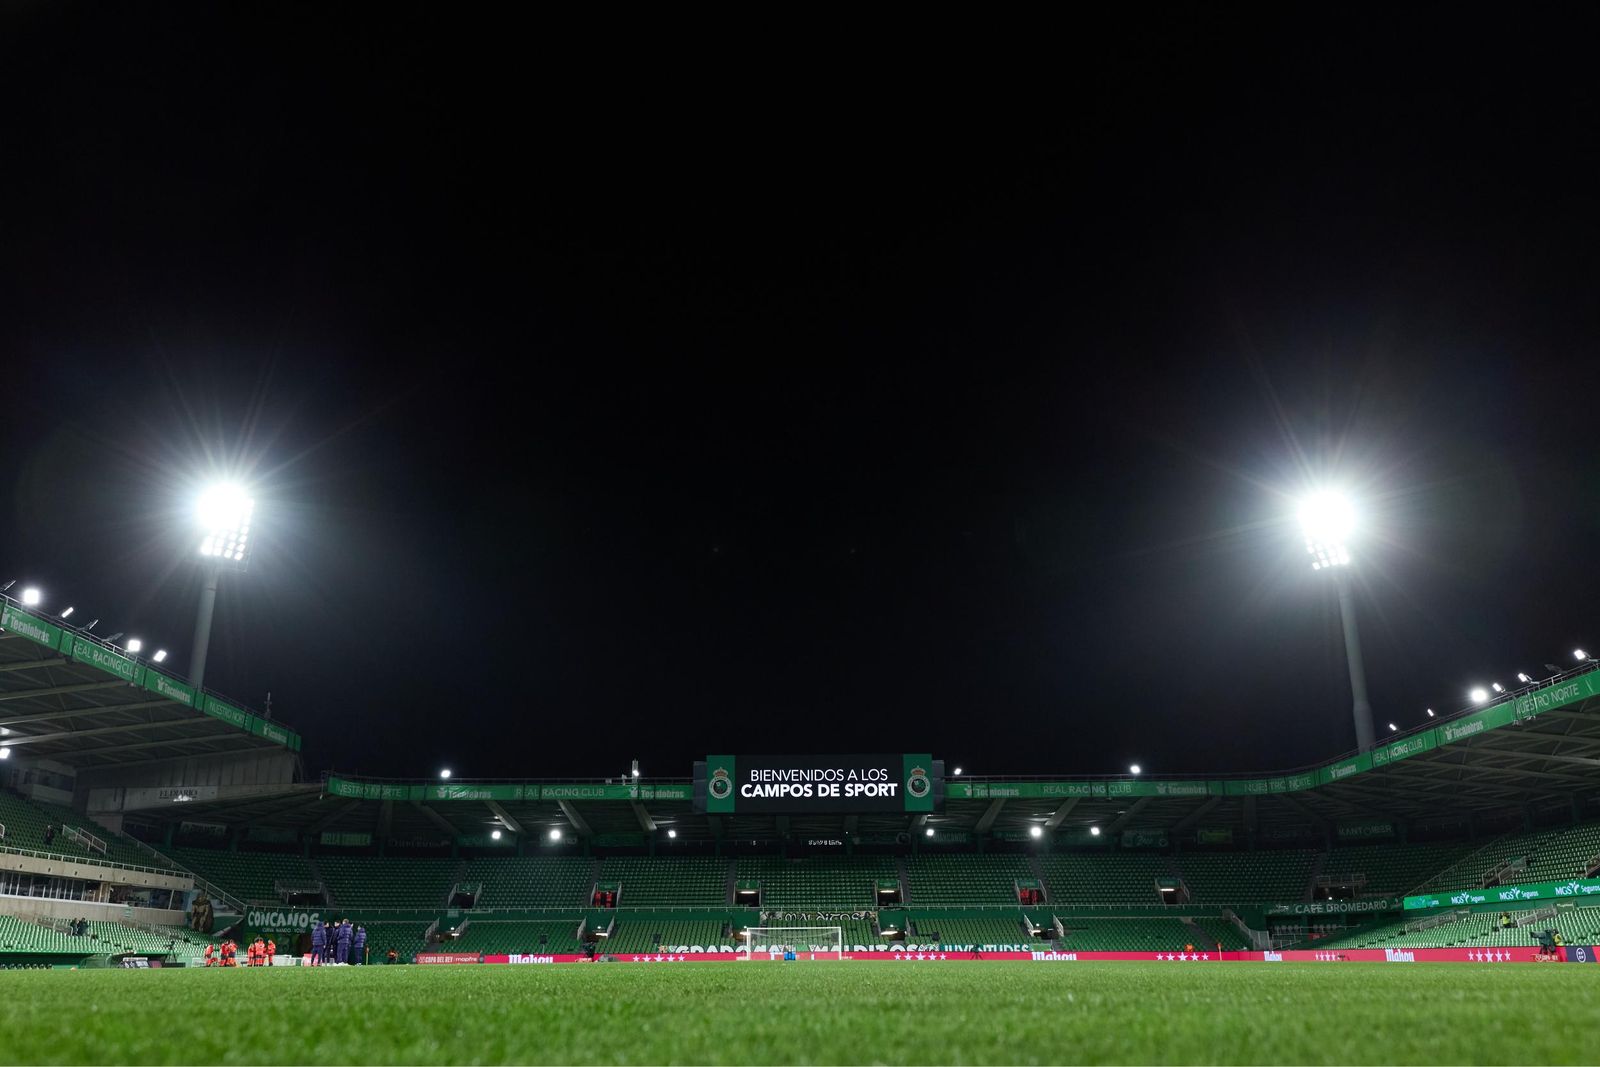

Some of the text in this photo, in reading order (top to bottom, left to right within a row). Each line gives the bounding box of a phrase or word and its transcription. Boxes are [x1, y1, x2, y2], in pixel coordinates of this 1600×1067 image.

[10, 615, 50, 643] Tecniobras
[73, 641, 139, 678] REAL RACING CLUB
[1551, 683, 1580, 702] NORTE
[751, 768, 888, 782] BIENVENIDOS A LOS
[516, 788, 605, 797] REAL RACING CLUB
[741, 784, 813, 798] CAMPOS
[818, 784, 841, 797] DE
[844, 783, 898, 797] SPORT
[1043, 784, 1132, 794] REAL RACING CLUB
[1499, 890, 1539, 900] MGS Seguros
[1555, 884, 1573, 895] MGS
[1326, 900, 1387, 912] DROMEDARIO
[1451, 896, 1464, 904] MGS
[247, 911, 320, 929] CONCANOS
[508, 954, 553, 963] Mahou
[1031, 952, 1077, 961] Mahou
[1385, 948, 1415, 962] Mahou
